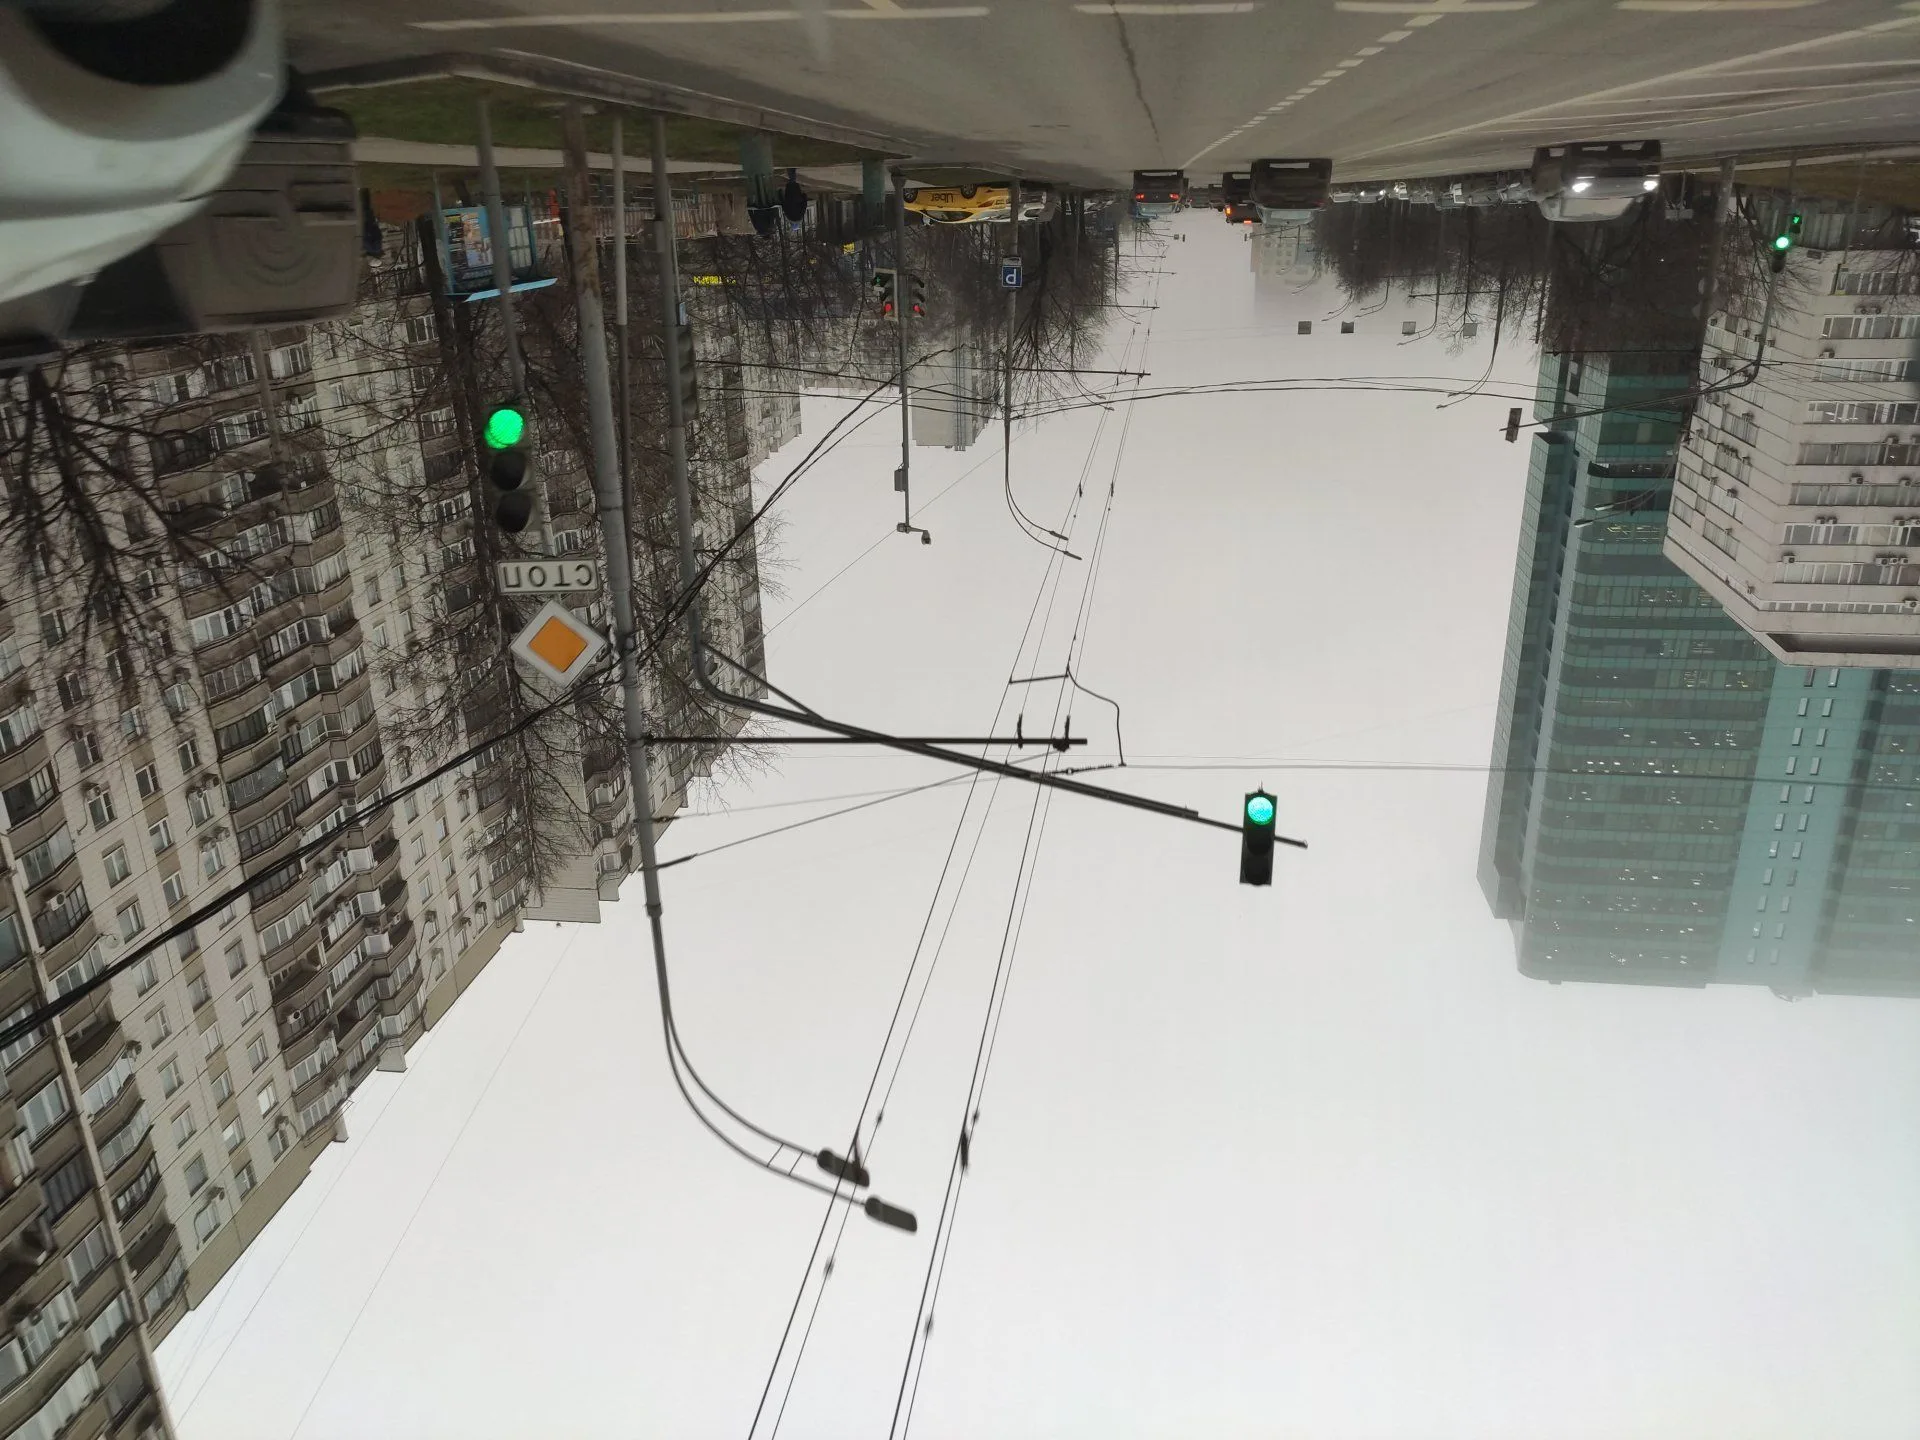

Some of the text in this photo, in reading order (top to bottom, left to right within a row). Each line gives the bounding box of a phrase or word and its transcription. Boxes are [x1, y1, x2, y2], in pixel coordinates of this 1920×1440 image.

[931, 192, 954, 203] Uber
[1006, 269, 1017, 285] P
[503, 564, 592, 588] СТОП
